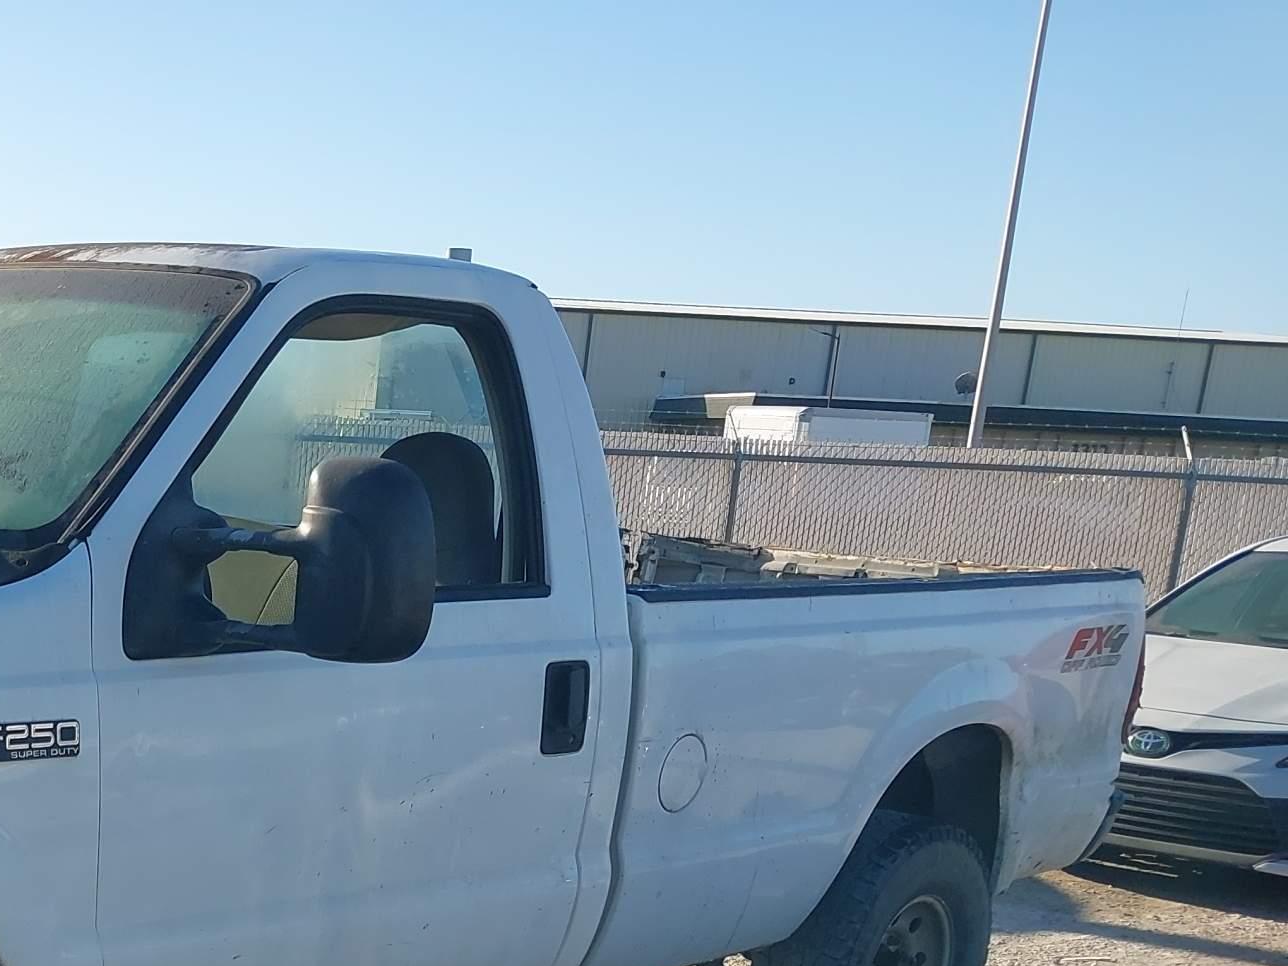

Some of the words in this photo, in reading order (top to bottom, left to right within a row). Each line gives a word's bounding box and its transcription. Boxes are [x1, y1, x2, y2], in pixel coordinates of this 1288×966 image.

[1065, 623, 1130, 660] FX4
[10, 749, 47, 759] SUPER
[50, 746, 79, 756] DUTY
